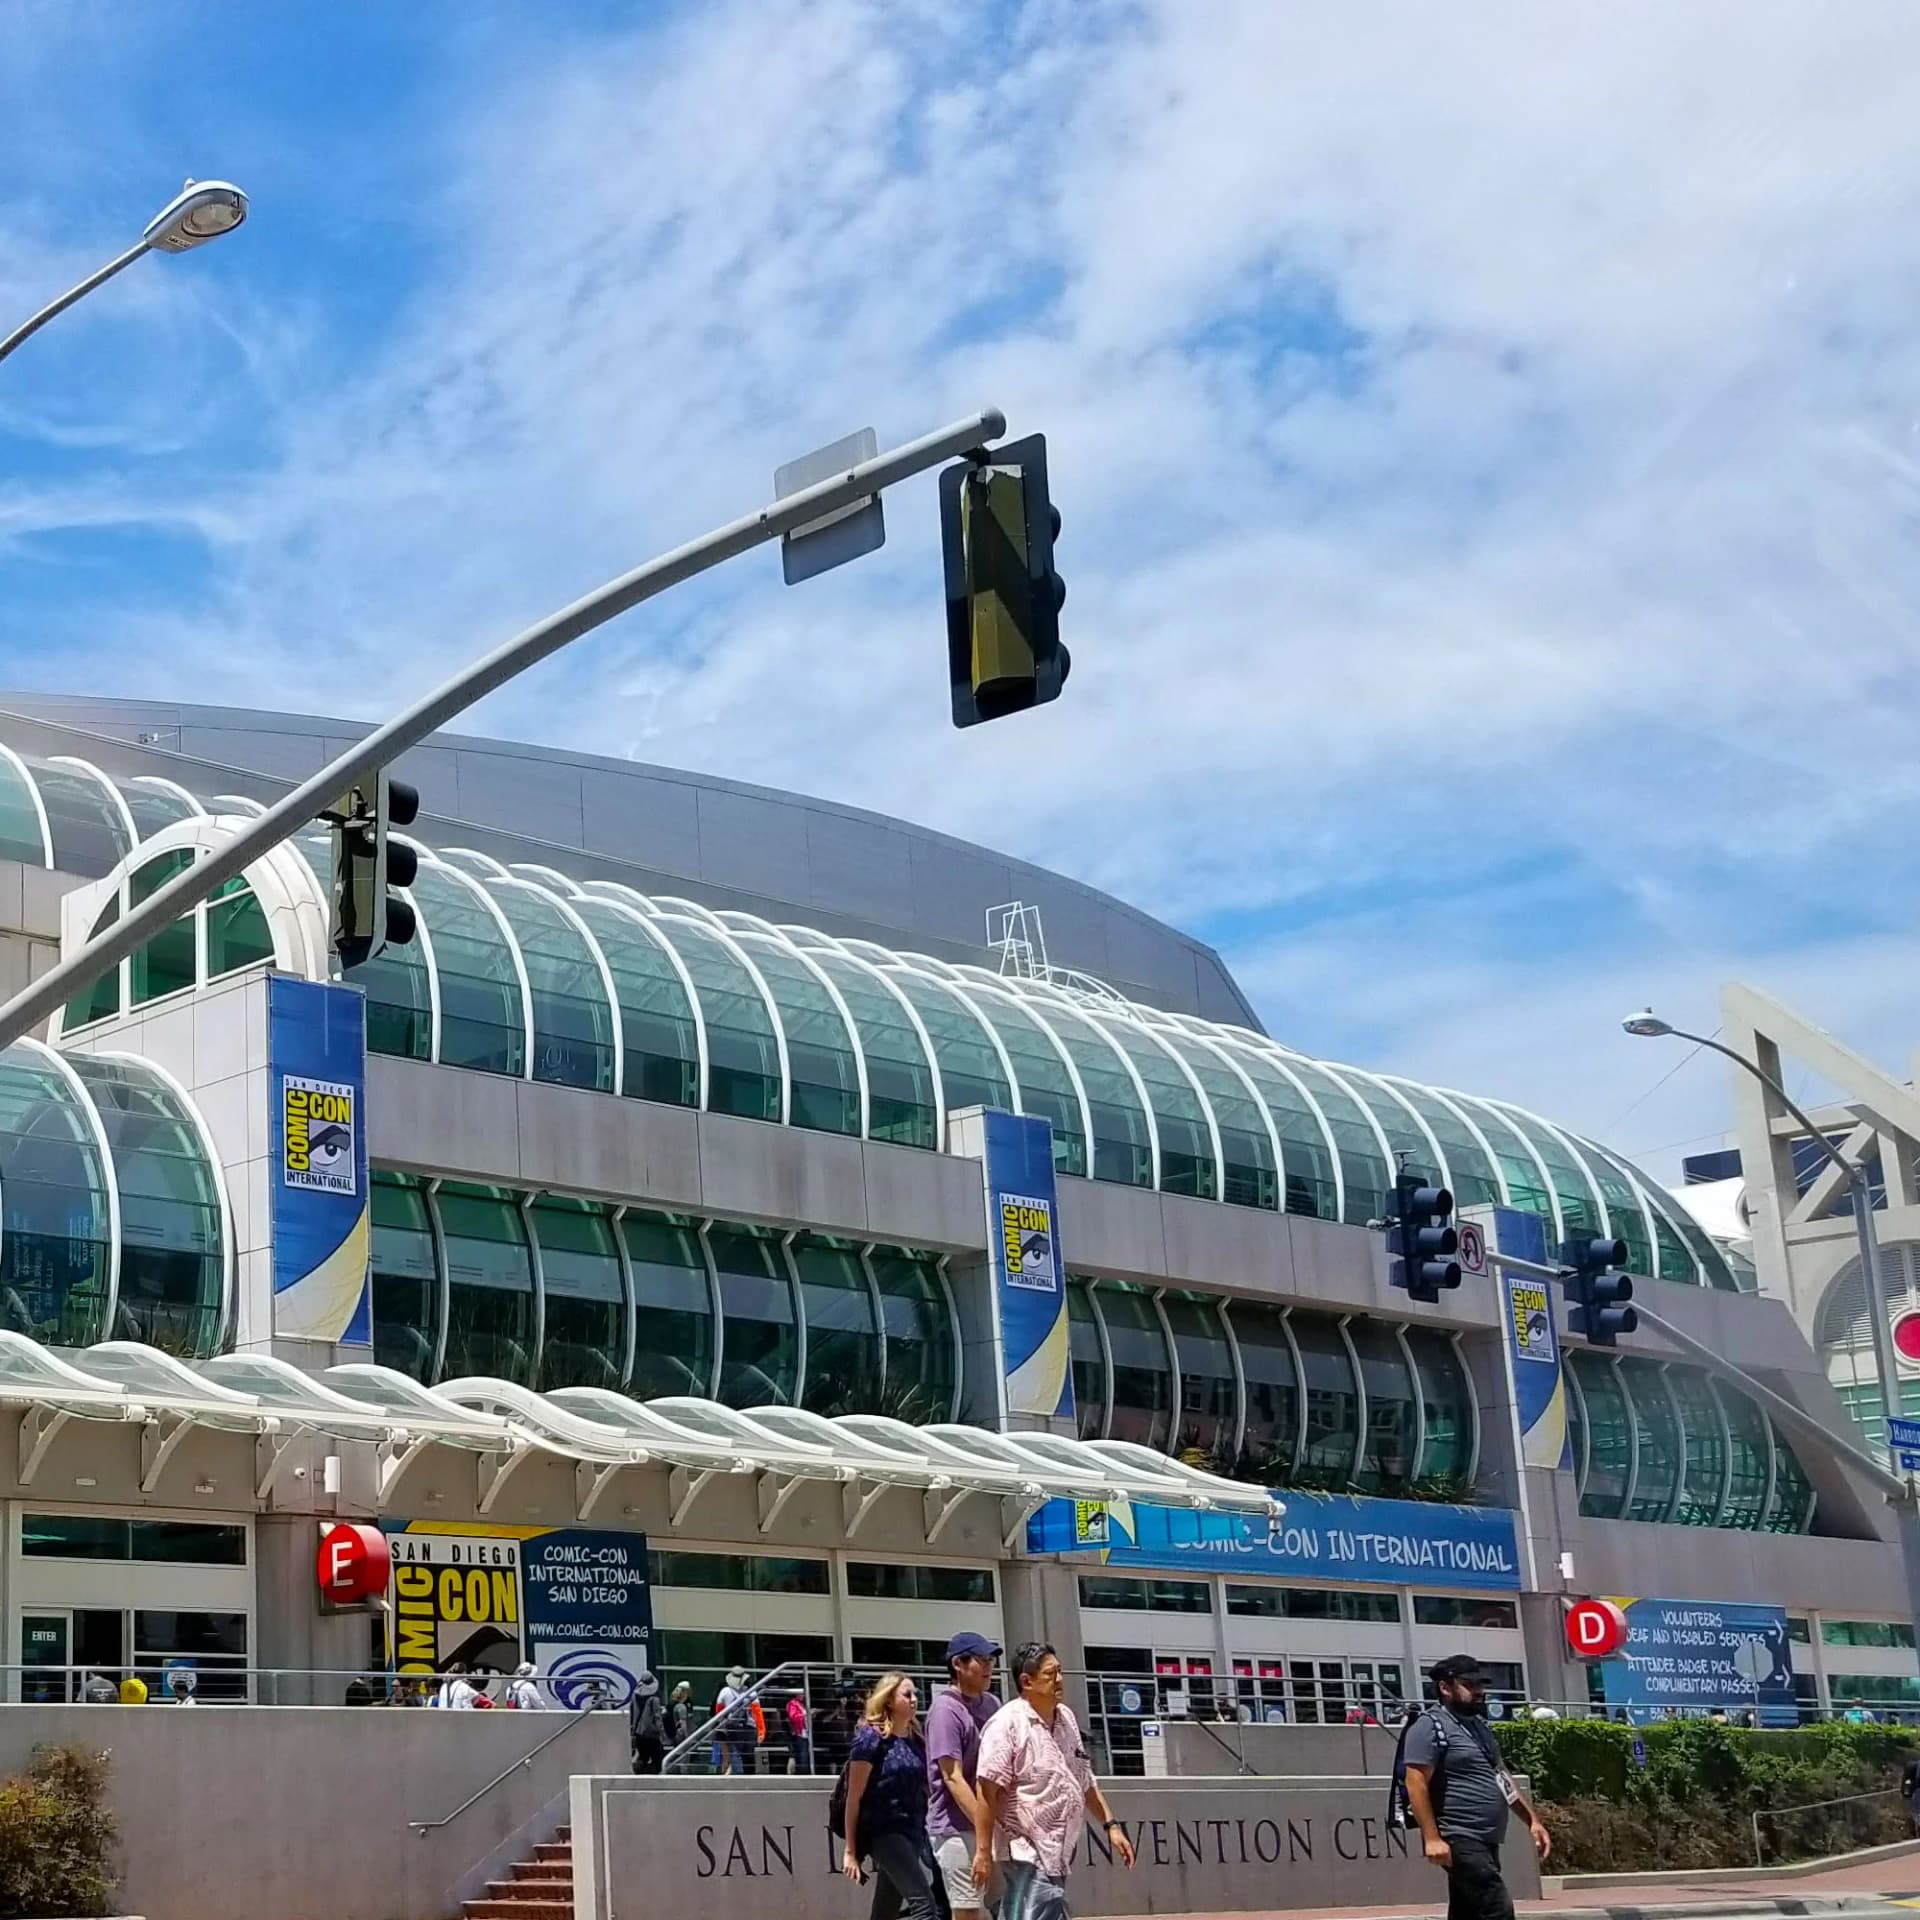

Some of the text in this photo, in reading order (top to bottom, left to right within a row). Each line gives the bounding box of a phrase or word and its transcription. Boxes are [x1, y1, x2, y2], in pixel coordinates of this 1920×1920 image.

[309, 1092, 350, 1123] CON
[287, 1090, 309, 1170] COMIC
[287, 1171, 352, 1190] INTERNATIONAL
[1020, 1208, 1048, 1231] CON
[1004, 1205, 1022, 1272] COMIC
[1524, 1291, 1545, 1311] CON
[1513, 1290, 1528, 1346] COMIC
[391, 1541, 516, 1566] SAN DIEGO
[543, 1544, 628, 1565] COMIC-CON
[1326, 1530, 1512, 1573] INTERNATIONAL
[331, 1541, 354, 1587] E
[528, 1564, 645, 1585] INTERNATIONAL
[438, 1567, 517, 1622] CON
[548, 1585, 628, 1605] SAN DIEGO
[1578, 1611, 1606, 1645] D
[1660, 1609, 1723, 1628] VOLUNTEERS
[31, 1630, 57, 1642] ENTER
[528, 1622, 649, 1638] WWW.COMIC-CON.ORG
[1652, 1627, 1670, 1645] AND
[1672, 1630, 1716, 1646] DISABLED
[1627, 1656, 1737, 1676] ATTENDEE BADGE PICK-
[1645, 1676, 1718, 1694] COMPLIMENTARY
[695, 1824, 795, 1878] SAN
